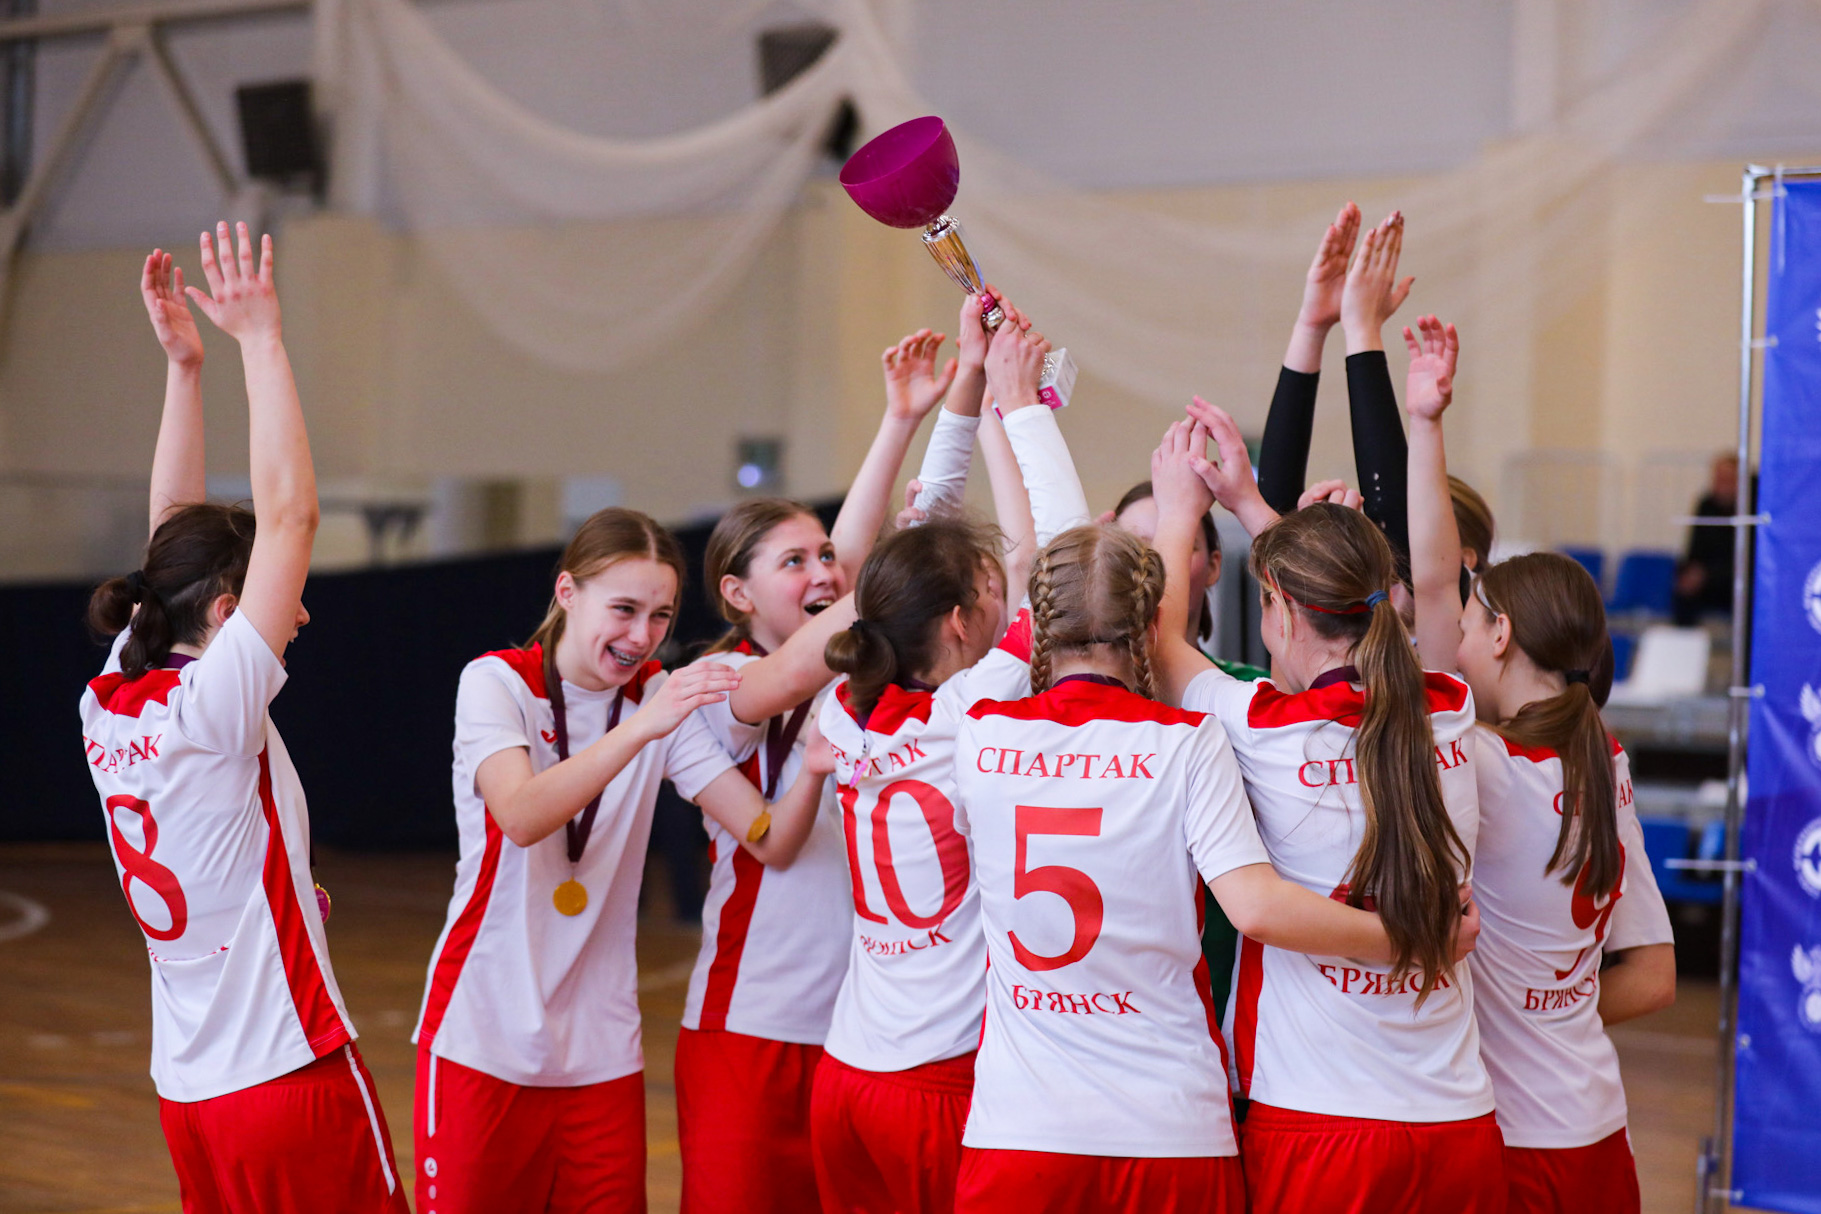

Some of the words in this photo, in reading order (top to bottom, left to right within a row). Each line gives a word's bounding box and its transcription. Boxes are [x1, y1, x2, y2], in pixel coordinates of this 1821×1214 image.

[976, 746, 1157, 780] СПАРТАК
[1297, 737, 1468, 788] СПАК
[106, 794, 188, 941] 8
[836, 779, 971, 929] 10
[1007, 804, 1104, 972] 5
[1011, 984, 1142, 1015] БРЯНСК
